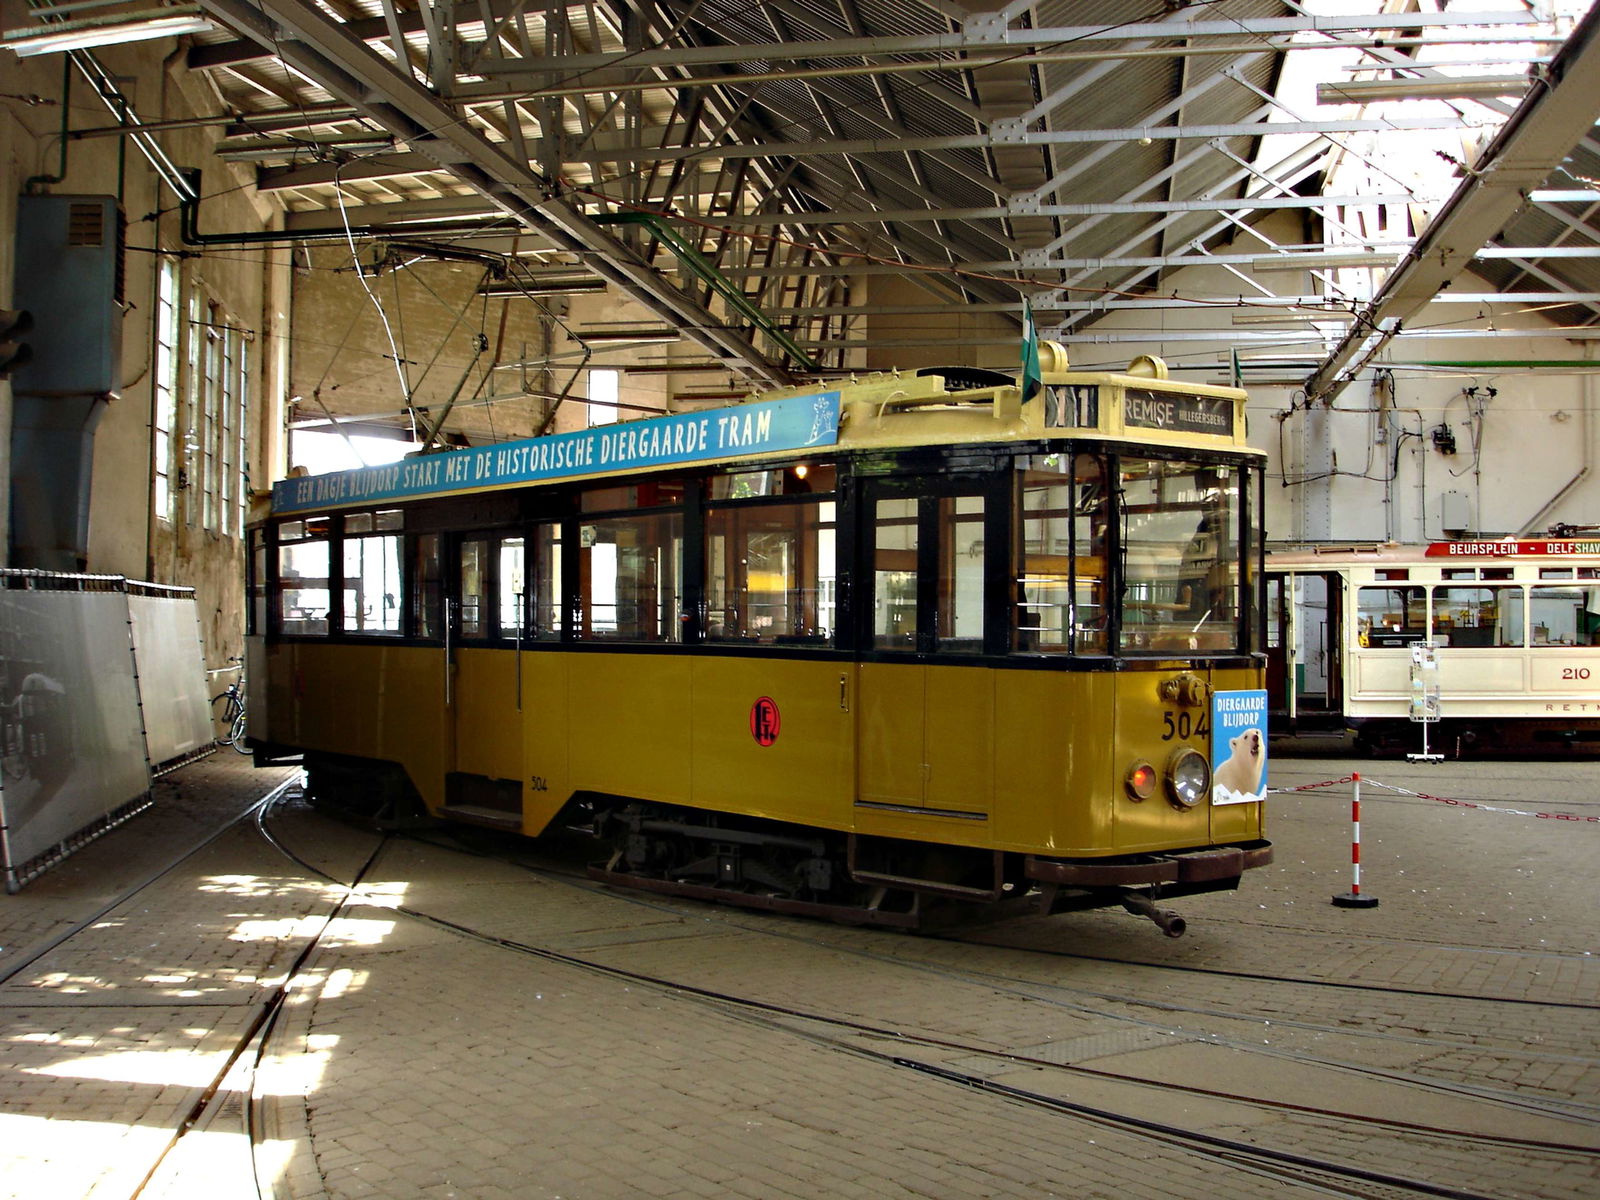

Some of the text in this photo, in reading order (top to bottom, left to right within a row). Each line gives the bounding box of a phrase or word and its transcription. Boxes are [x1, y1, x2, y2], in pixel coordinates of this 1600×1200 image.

[1125, 398, 1226, 426] REMISE HILLEGERSBERG
[296, 409, 773, 504] EEN DAGJE BLIJDORP START MET DE HISTORISCHE DIERGAARDE TRAM
[1449, 543, 1519, 555] BEURSPLEIN
[1547, 543, 1600, 554] DELFSHAV
[1562, 668, 1590, 680] 210
[1217, 697, 1265, 712] DIERGAARDE
[1162, 712, 1209, 741] 504
[1223, 712, 1260, 728] BLIJDORP
[531, 776, 548, 791] 504
